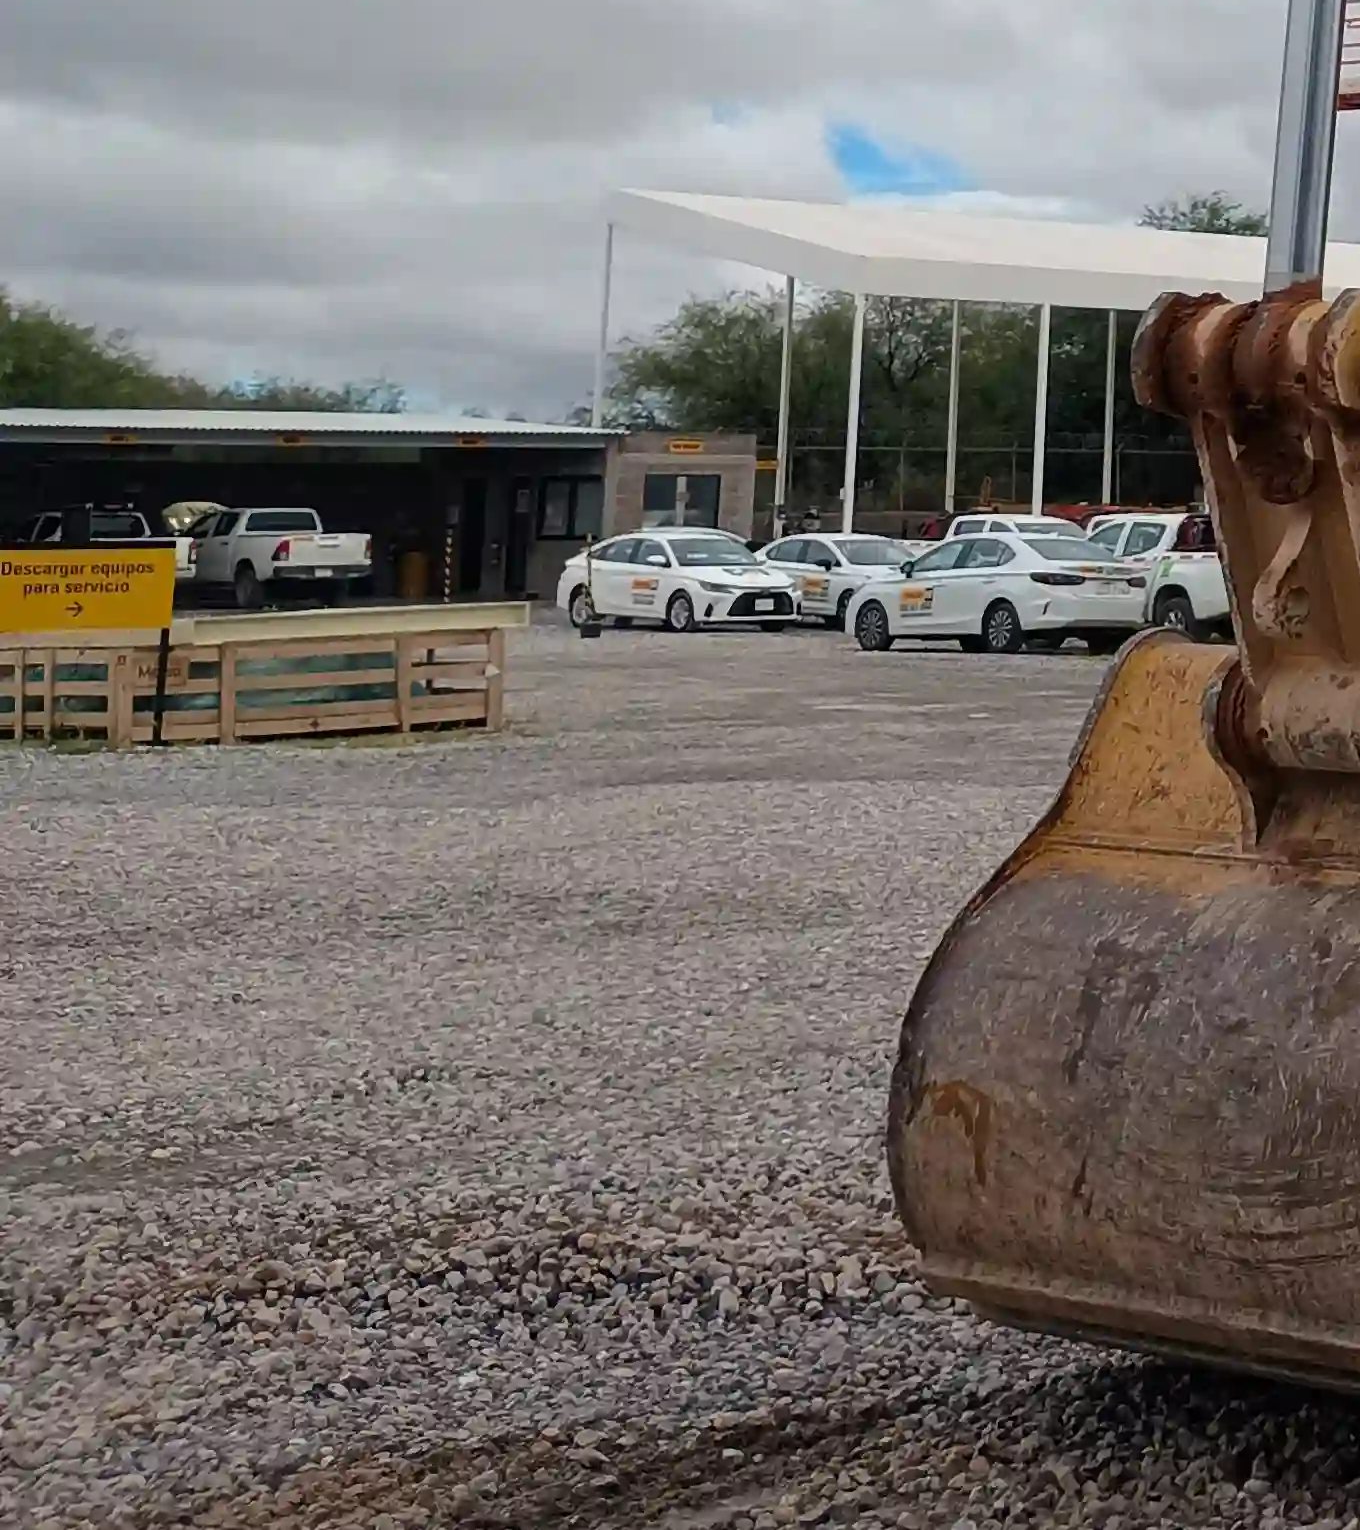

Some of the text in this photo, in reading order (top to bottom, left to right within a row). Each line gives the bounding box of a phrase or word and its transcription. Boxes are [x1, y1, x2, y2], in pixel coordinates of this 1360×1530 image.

[1, 561, 156, 578] Descargar equipos
[23, 581, 130, 599] para servicio
